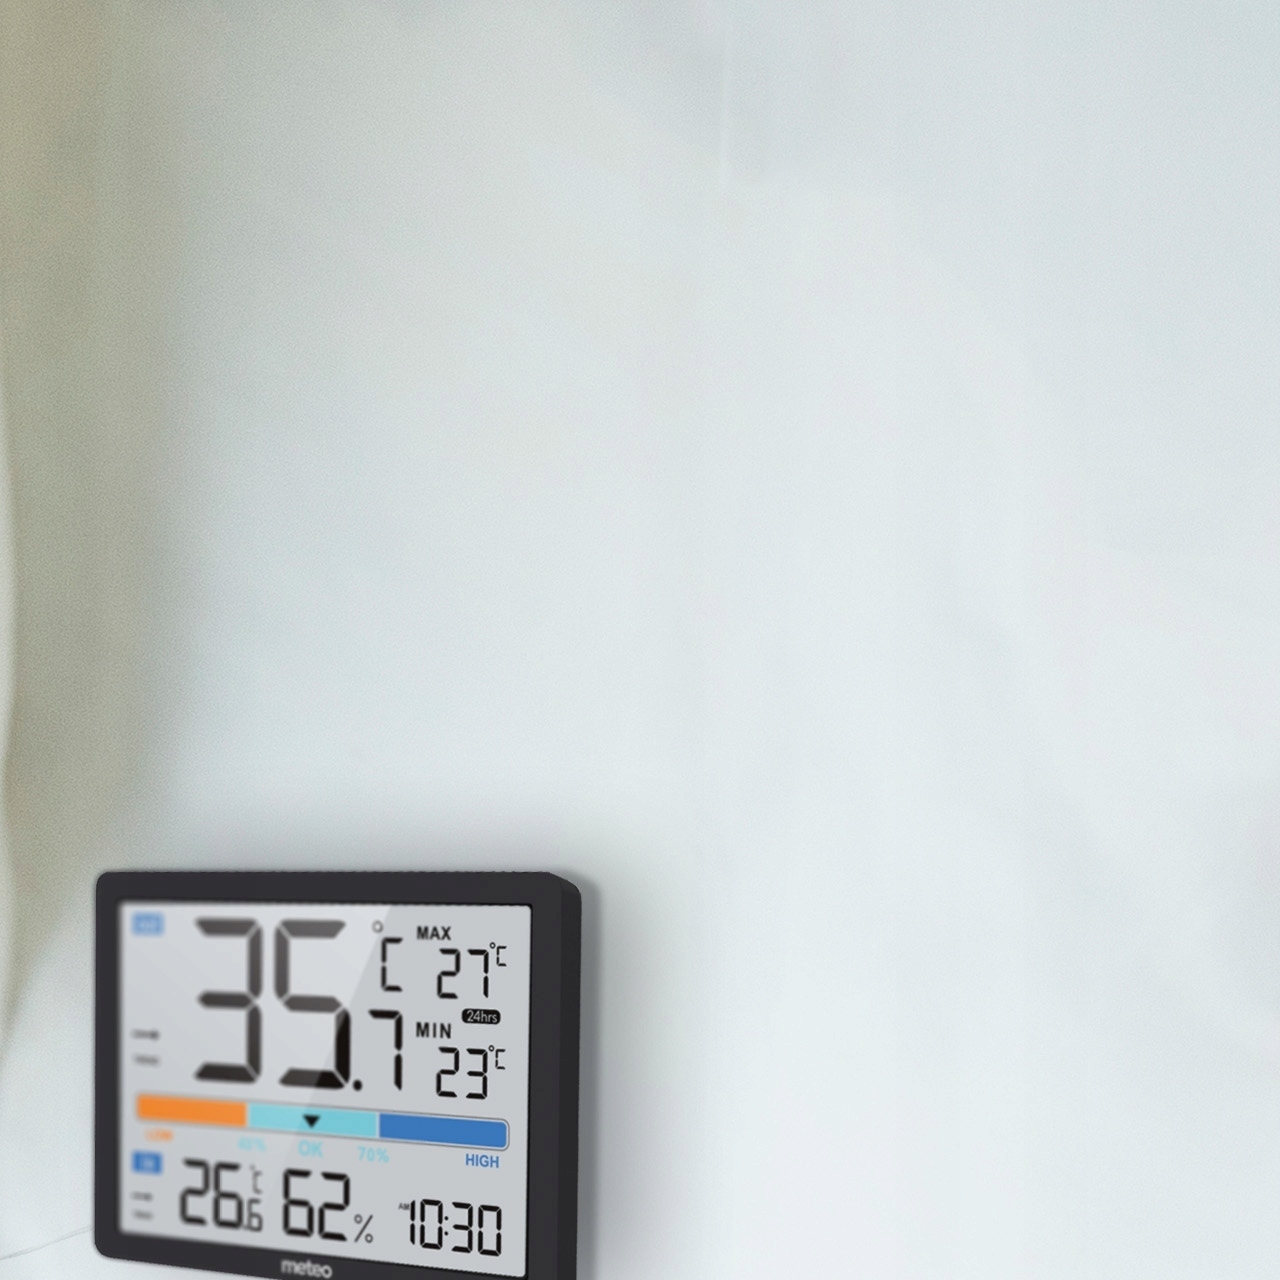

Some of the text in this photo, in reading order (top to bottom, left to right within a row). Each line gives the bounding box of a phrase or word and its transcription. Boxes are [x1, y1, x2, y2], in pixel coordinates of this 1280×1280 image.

[416, 925, 451, 940] MAX
[194, 917, 403, 1091] 35.7
[466, 1010, 498, 1023] 24hrs
[416, 1022, 451, 1039] MIN
[297, 1140, 324, 1158] OK
[357, 1146, 390, 1163] 70%
[465, 1153, 500, 1168] HIGH
[410, 1198, 502, 1257] 10:30
[281, 1259, 333, 1279] meteo
